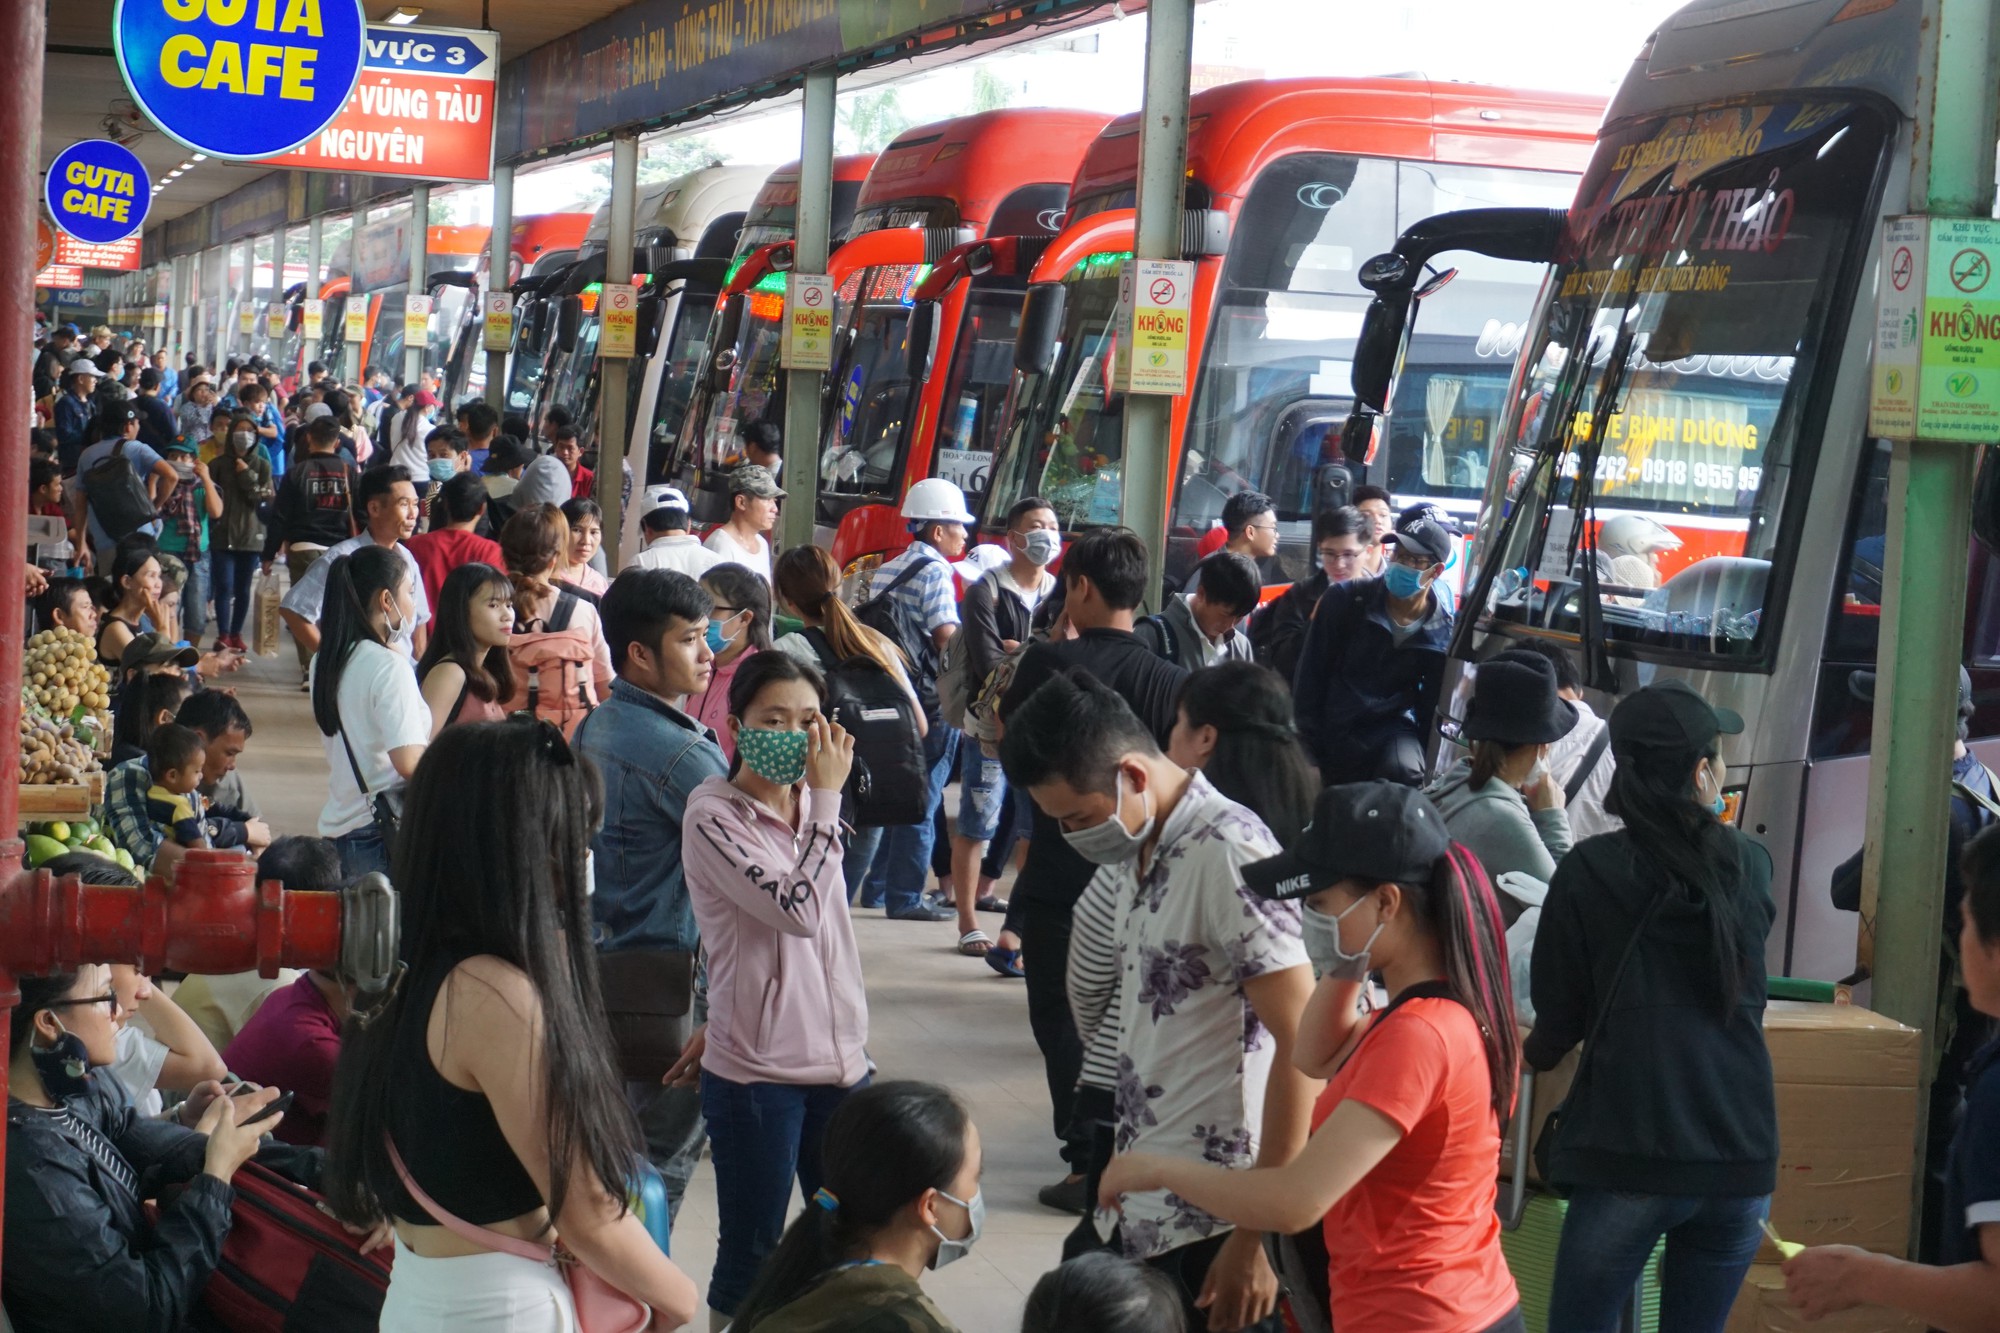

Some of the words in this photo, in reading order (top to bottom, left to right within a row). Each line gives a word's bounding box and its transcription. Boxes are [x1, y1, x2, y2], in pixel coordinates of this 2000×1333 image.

[367, 39, 438, 66] VỰC
[446, 46, 466, 65] 3
[632, 22, 647, 86] BÀ
[648, 27, 666, 91] RỊA
[674, 3, 707, 73] VŨNG
[160, 34, 319, 102] CAFE
[359, 78, 429, 117] VŨNG
[435, 84, 483, 123] TÀU
[320, 127, 424, 165] NGUYÊN
[65, 160, 135, 198] GUTA
[62, 189, 132, 225] CAFE
[1937, 232, 1953, 242] CẤM
[1952, 223, 1971, 232] KHU
[1973, 223, 1991, 234] VỰC
[607, 311, 634, 325] KHÔNG
[795, 310, 829, 328] KHÔNG
[1138, 309, 1184, 334] KHÔNG
[1930, 301, 2000, 342] KHÔNG
[1628, 409, 1676, 442] BÌNH
[1682, 416, 1758, 450] DƯƠNG
[968, 464, 990, 492] 6
[1594, 455, 1628, 481] 262
[1641, 457, 1688, 485] 0918
[1693, 461, 1735, 490] 955
[1737, 465, 1763, 491] 95
[1275, 873, 1312, 897] NIKE
